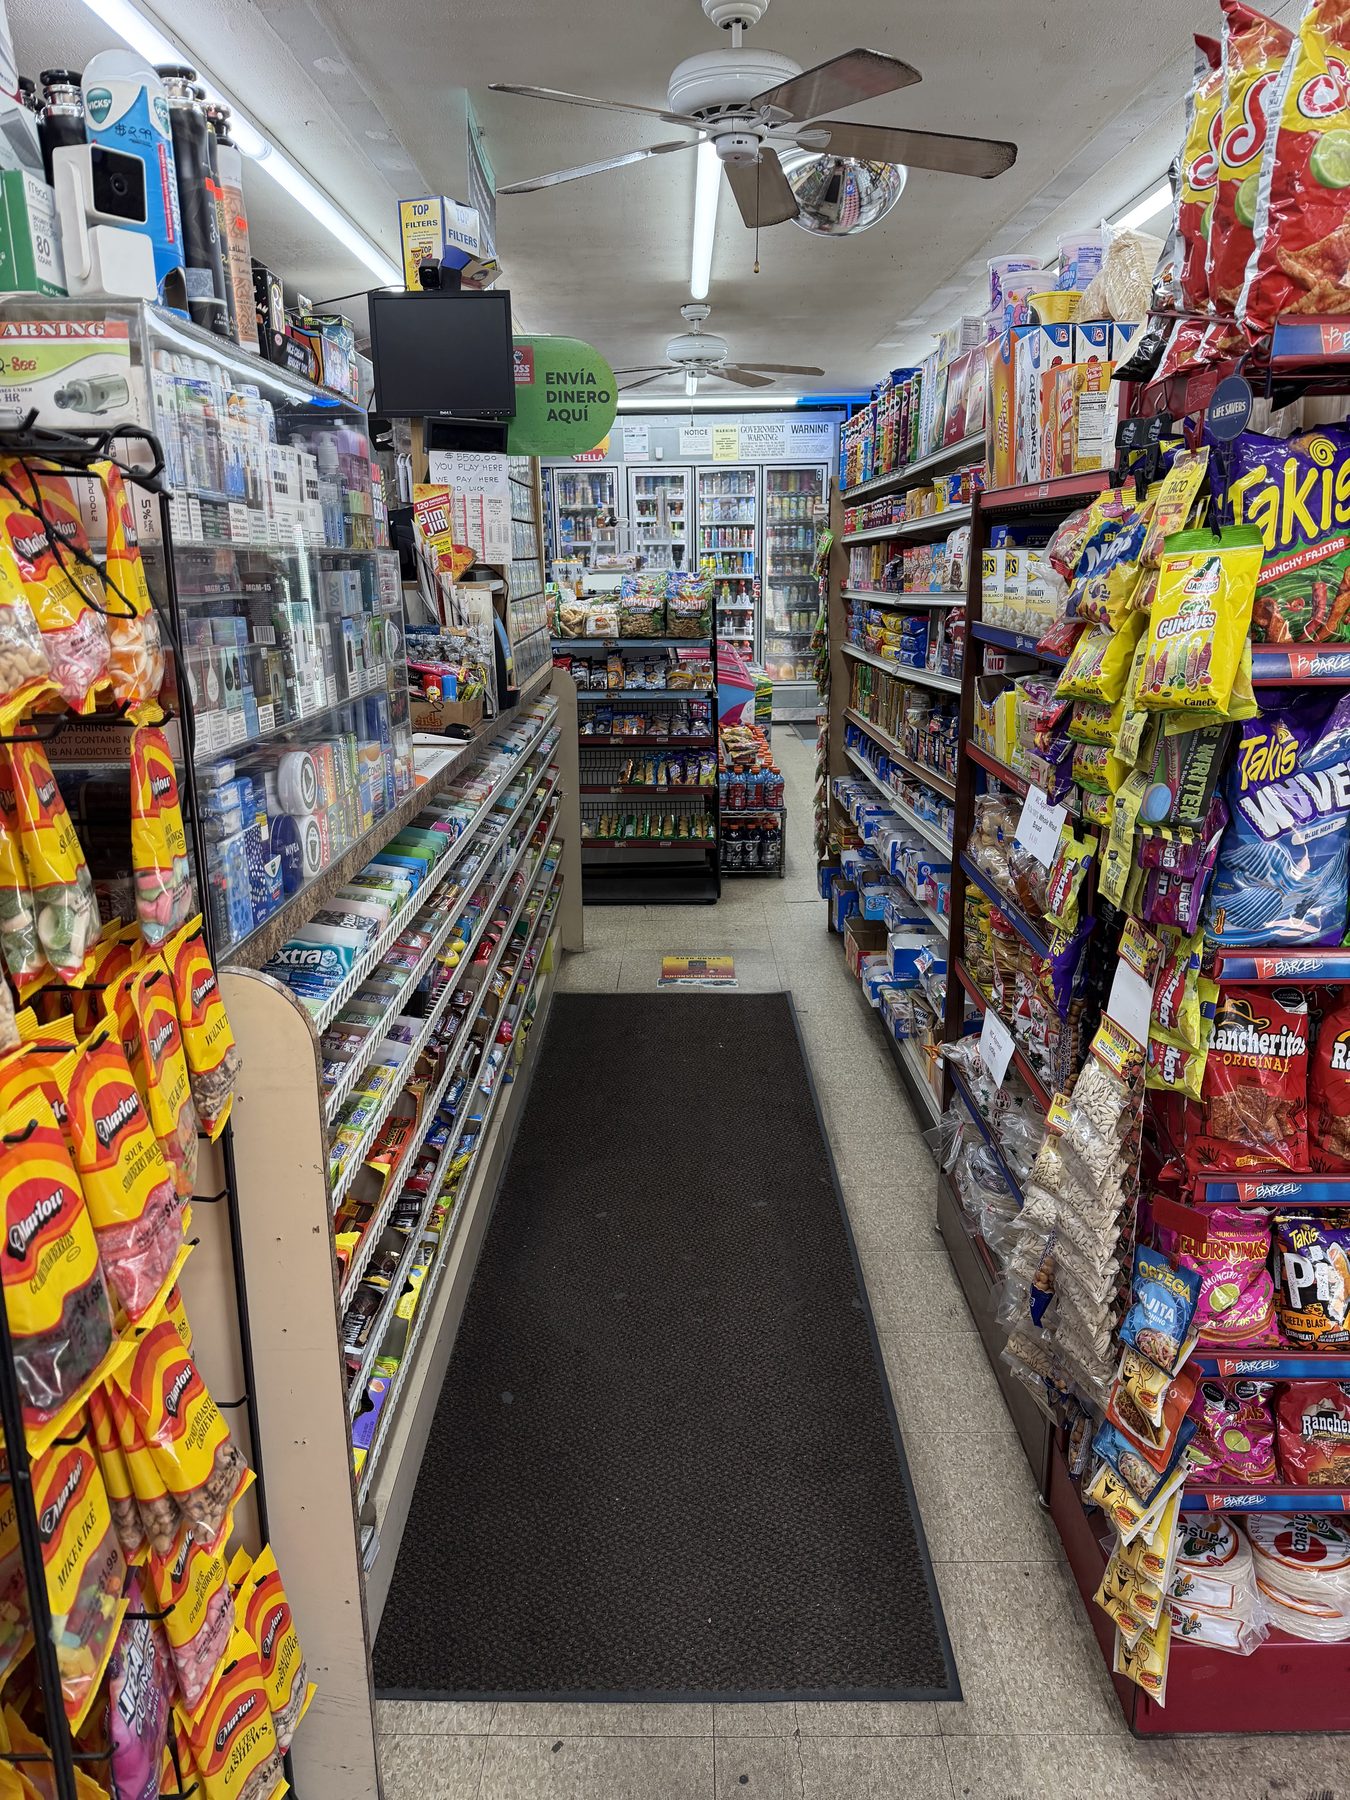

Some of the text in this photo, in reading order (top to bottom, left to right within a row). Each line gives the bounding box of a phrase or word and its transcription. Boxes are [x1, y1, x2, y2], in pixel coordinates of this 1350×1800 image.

[412, 204, 429, 216] TOP
[405, 219, 438, 229] FILTERS
[37, 234, 50, 257] 80
[448, 228, 478, 249] FILTERS
[3, 321, 106, 336] ARNING
[514, 364, 530, 373] OSS
[545, 368, 597, 385] ENVÍA
[546, 390, 610, 403] DINERO
[546, 404, 589, 424] AQUÍ
[1212, 401, 1246, 419] LIFE SAVERS
[684, 428, 708, 436] NOTICE
[740, 425, 785, 434] GOVERNMENT
[791, 424, 829, 434] WARNING
[434, 462, 503, 472] YOU PLAY HERE
[1168, 480, 1189, 494] TACO
[141, 498, 152, 520] 5%
[417, 501, 429, 510] 120
[419, 508, 445, 523] slim
[425, 518, 449, 537] jim
[1257, 537, 1345, 583] CRUNCHY FAJITAS
[245, 583, 271, 592] MGM-15
[1158, 612, 1216, 638] GUMMIES
[1309, 653, 1350, 677] BARCE
[1184, 697, 1217, 707] Canel's
[76, 735, 117, 745] CONTAINS
[59, 747, 72, 756] AN
[74, 747, 123, 756] ADDICTIVE
[1239, 733, 1299, 791] Takis
[1180, 743, 1216, 820] WRITER
[1240, 762, 1350, 841] WAVE
[1304, 823, 1336, 840] BLUE HEAT
[285, 842, 300, 856] NIVEA
[274, 948, 322, 965] xtra
[1274, 958, 1323, 975] BARCEL
[191, 975, 216, 1004] Marlow
[1222, 1054, 1290, 1073] ORIGINAL
[96, 1092, 138, 1142] Marlow
[124, 1140, 144, 1165] SOUR
[1255, 1182, 1302, 1197] BARCEL
[164, 1191, 180, 1218] $1.9
[8, 1189, 65, 1254] Marlow
[1289, 1226, 1320, 1249] Takis
[1138, 1261, 1191, 1303] ORTEGA
[1306, 1317, 1326, 1328] BLAST
[1234, 1360, 1279, 1373] BARCEL
[165, 1364, 191, 1411] Marlow
[196, 1405, 218, 1450] CASHEWS
[40, 1456, 83, 1534] Marlow
[1222, 1494, 1267, 1507] BARCEL
[57, 1543, 80, 1591] MIKE
[81, 1507, 97, 1543] IKE
[98, 1550, 118, 1590] $1.99
[262, 1606, 284, 1654] Marlow
[278, 1635, 292, 1672] SALTED
[217, 1692, 257, 1746] Marlow
[231, 1725, 256, 1761] SALTED
[224, 1722, 268, 1784] CASHEWS
